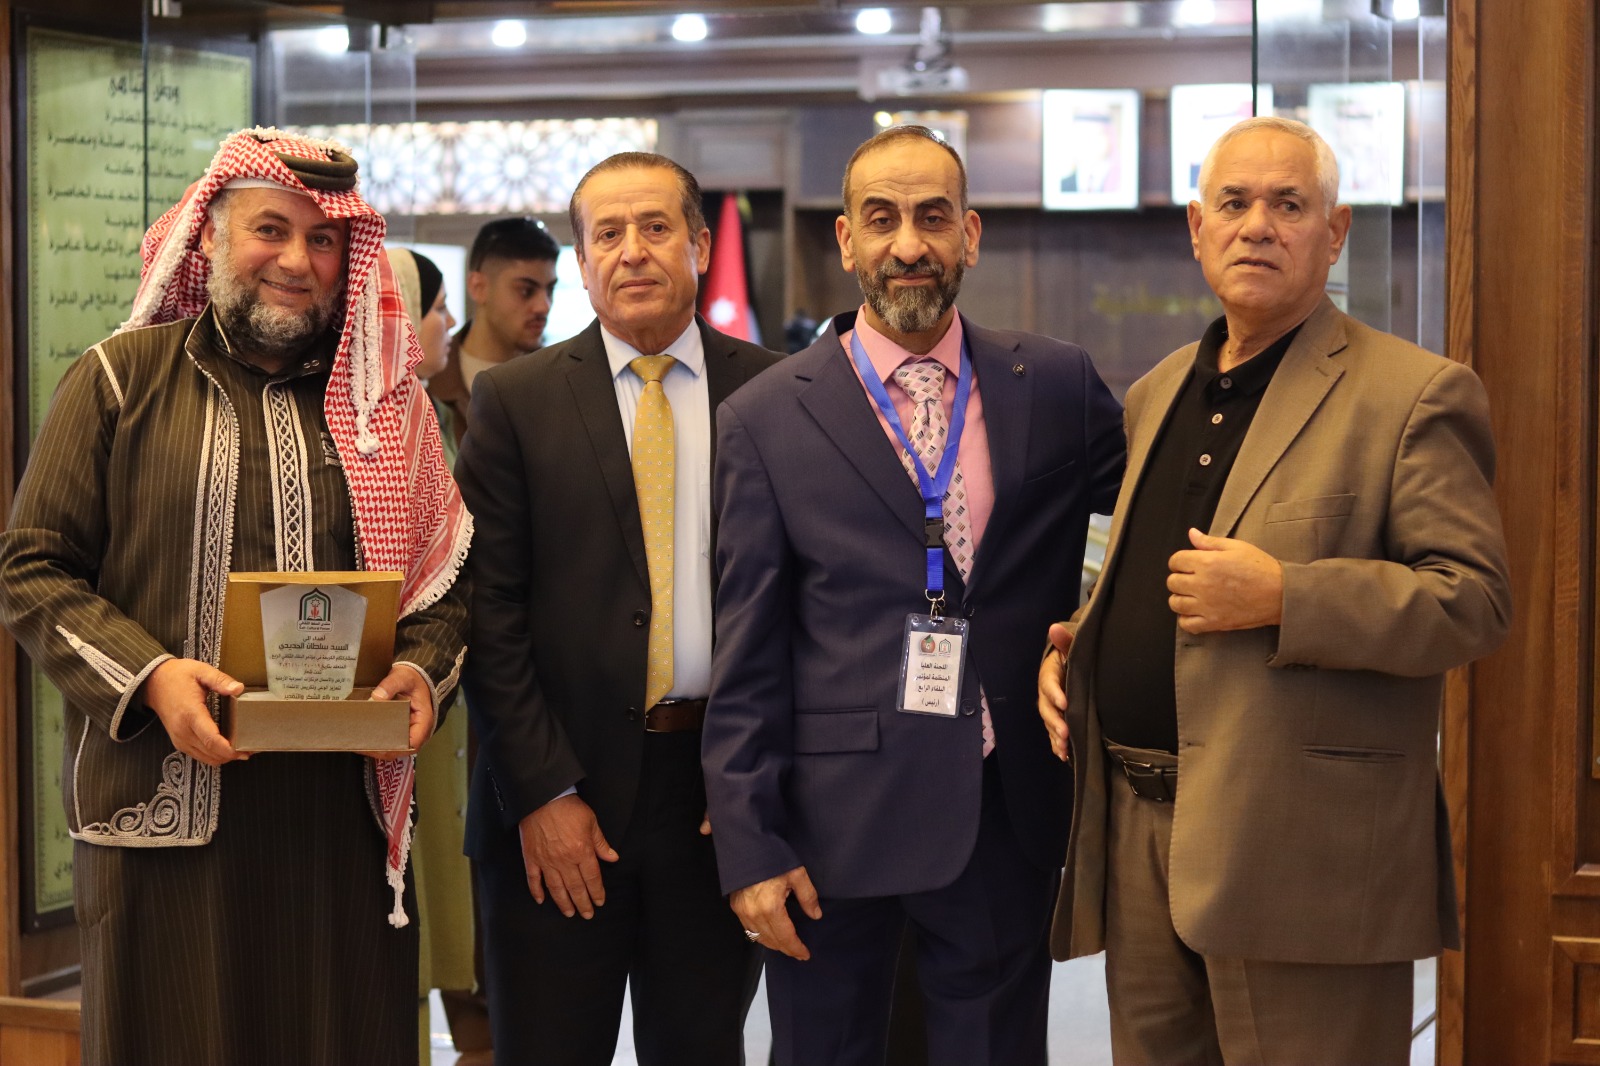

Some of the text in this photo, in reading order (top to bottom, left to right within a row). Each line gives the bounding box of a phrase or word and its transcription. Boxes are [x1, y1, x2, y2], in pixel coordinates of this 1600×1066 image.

[306, 642, 329, 650] سلطان
[330, 643, 349, 653] السيد
[920, 662, 932, 670] العليا
